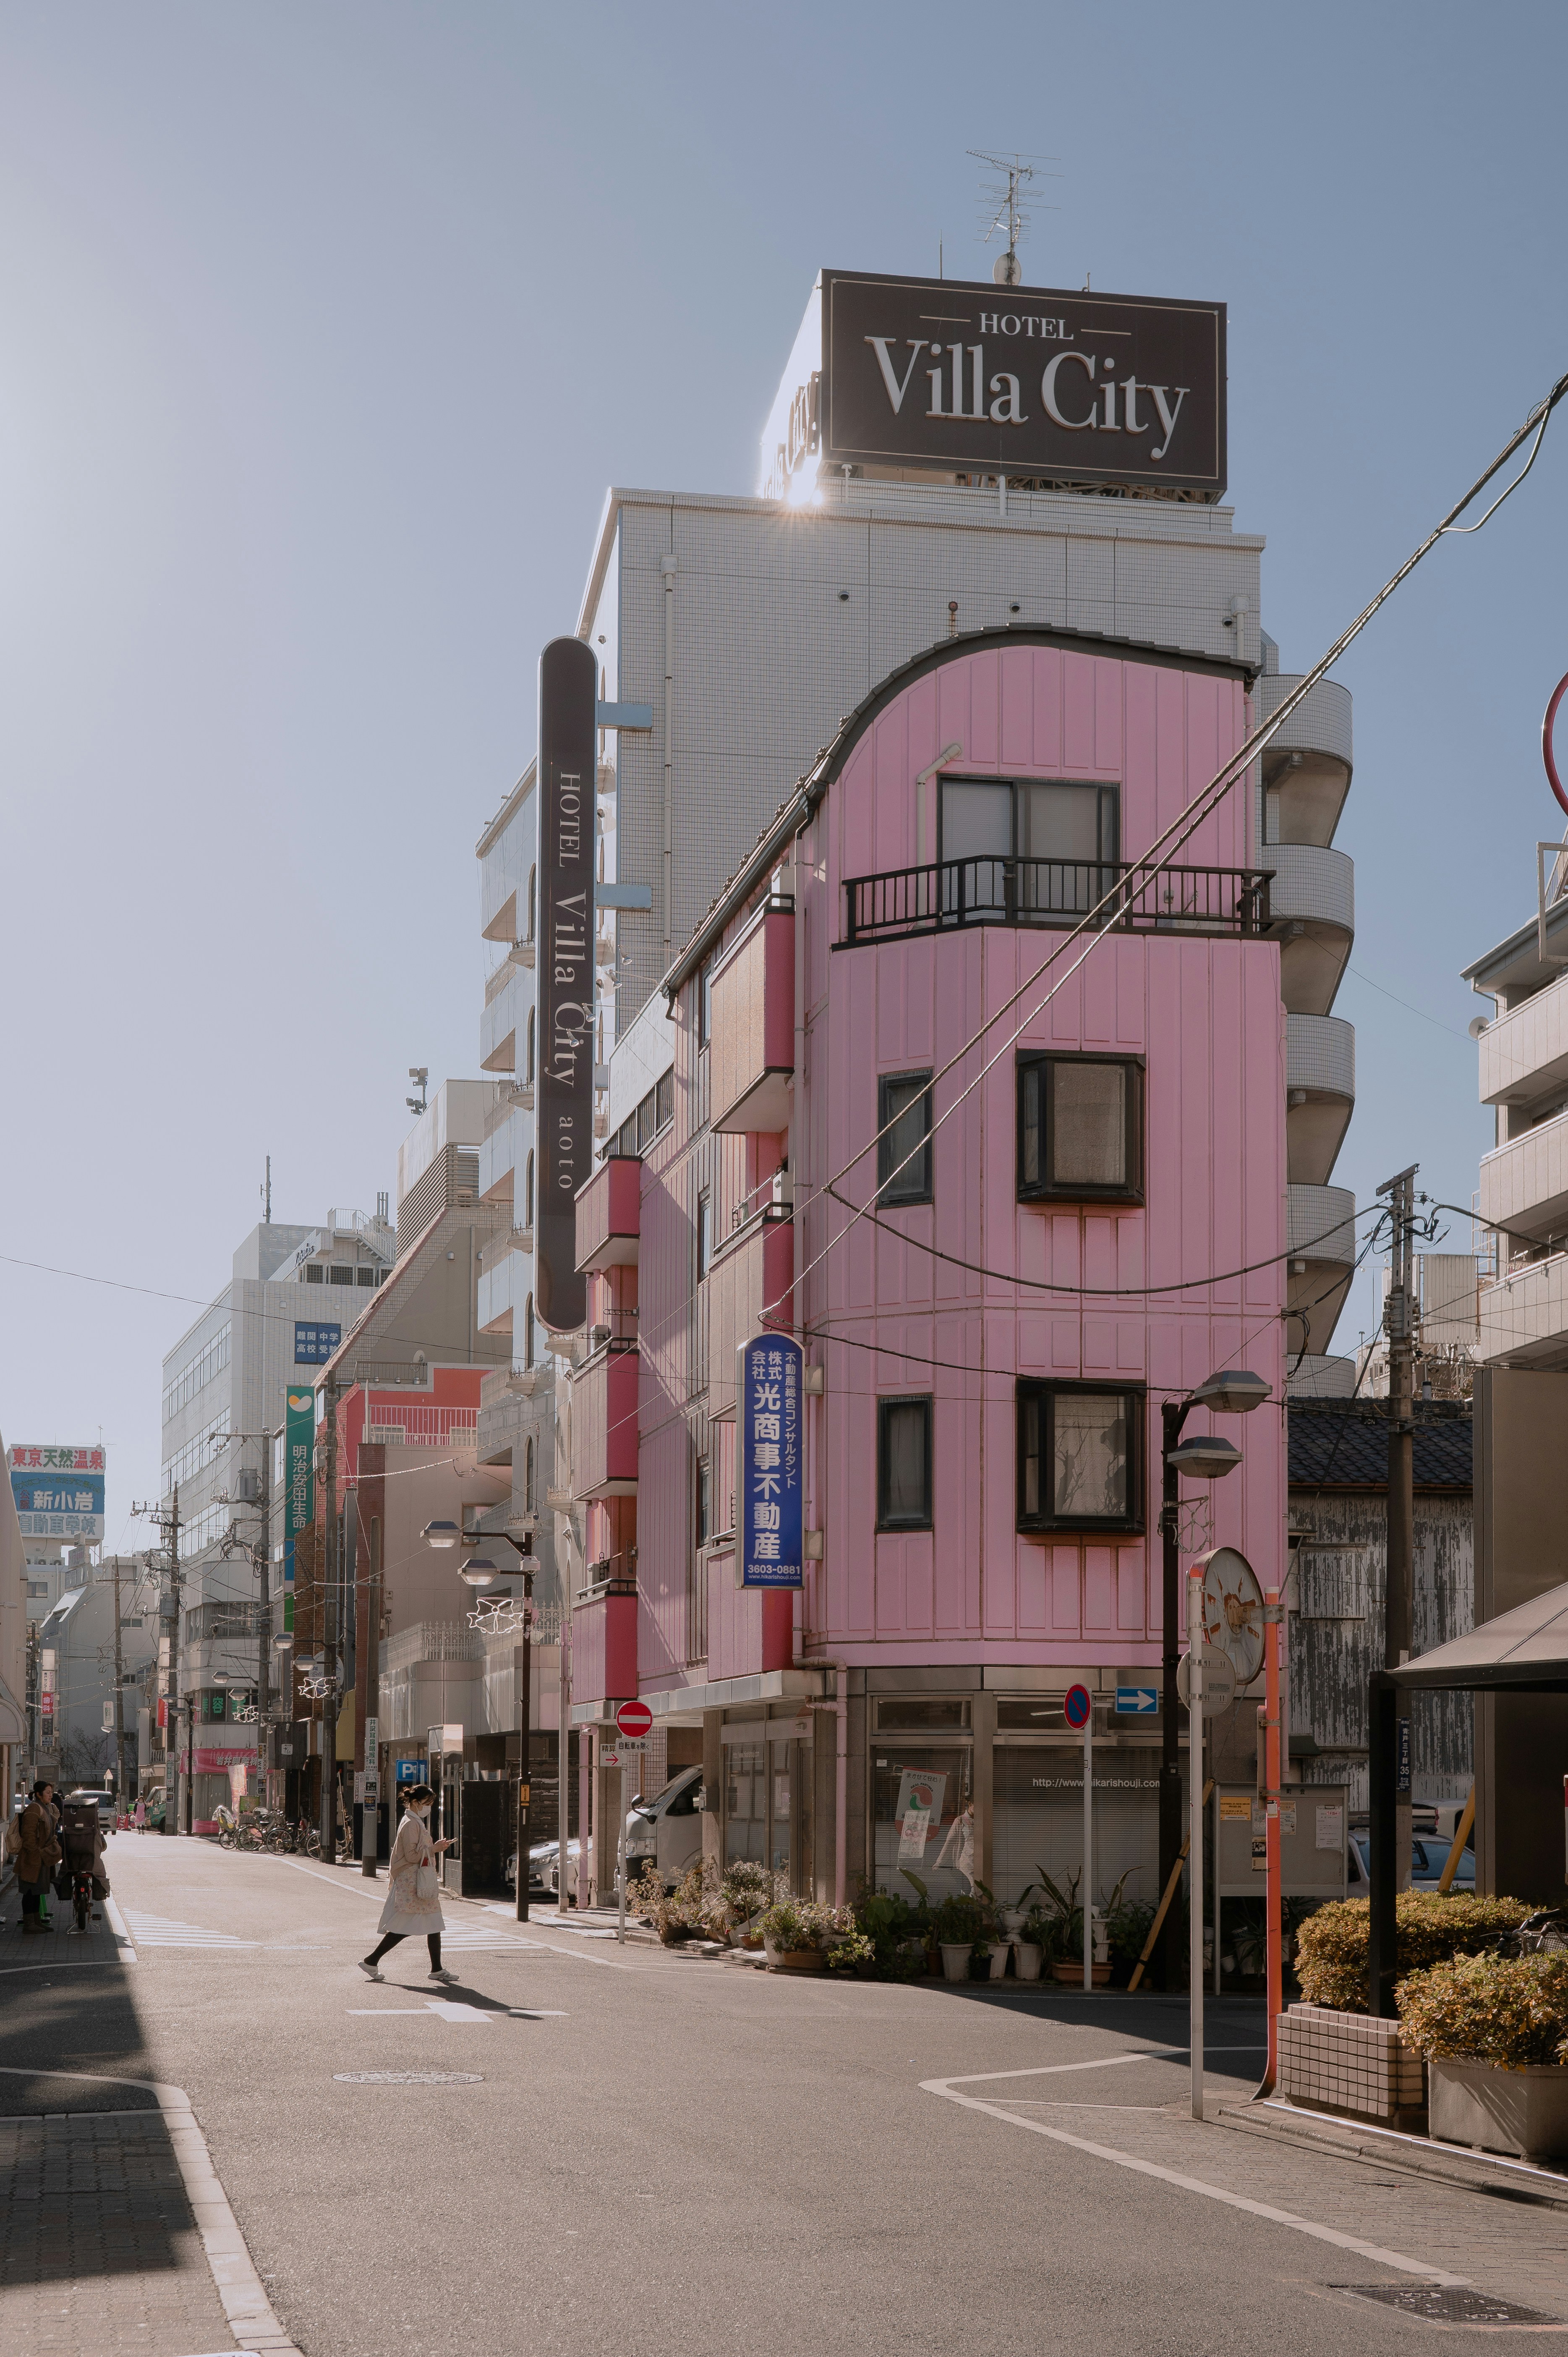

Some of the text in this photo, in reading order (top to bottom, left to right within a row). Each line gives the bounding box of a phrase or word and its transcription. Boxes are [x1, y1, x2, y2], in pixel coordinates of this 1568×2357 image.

[979, 312, 1074, 340] HOTEL
[864, 335, 1190, 460] Villa City
[544, 772, 587, 1190] HOTEL Villa City aoto
[784, 1352, 797, 1488] 不動産総合コンサルタント
[12, 1447, 104, 1470] 東京天然温泉
[753, 1383, 781, 1559] 光商事不動産
[292, 1445, 307, 1529] 明治安田生命
[33, 1490, 94, 1511] 新小岩
[19, 1514, 97, 1536] 自動車学校
[747, 1564, 800, 1574] 3603-0881
[618, 1742, 650, 1750] 自転車を除く
[1400, 1766, 1409, 1775] 35
